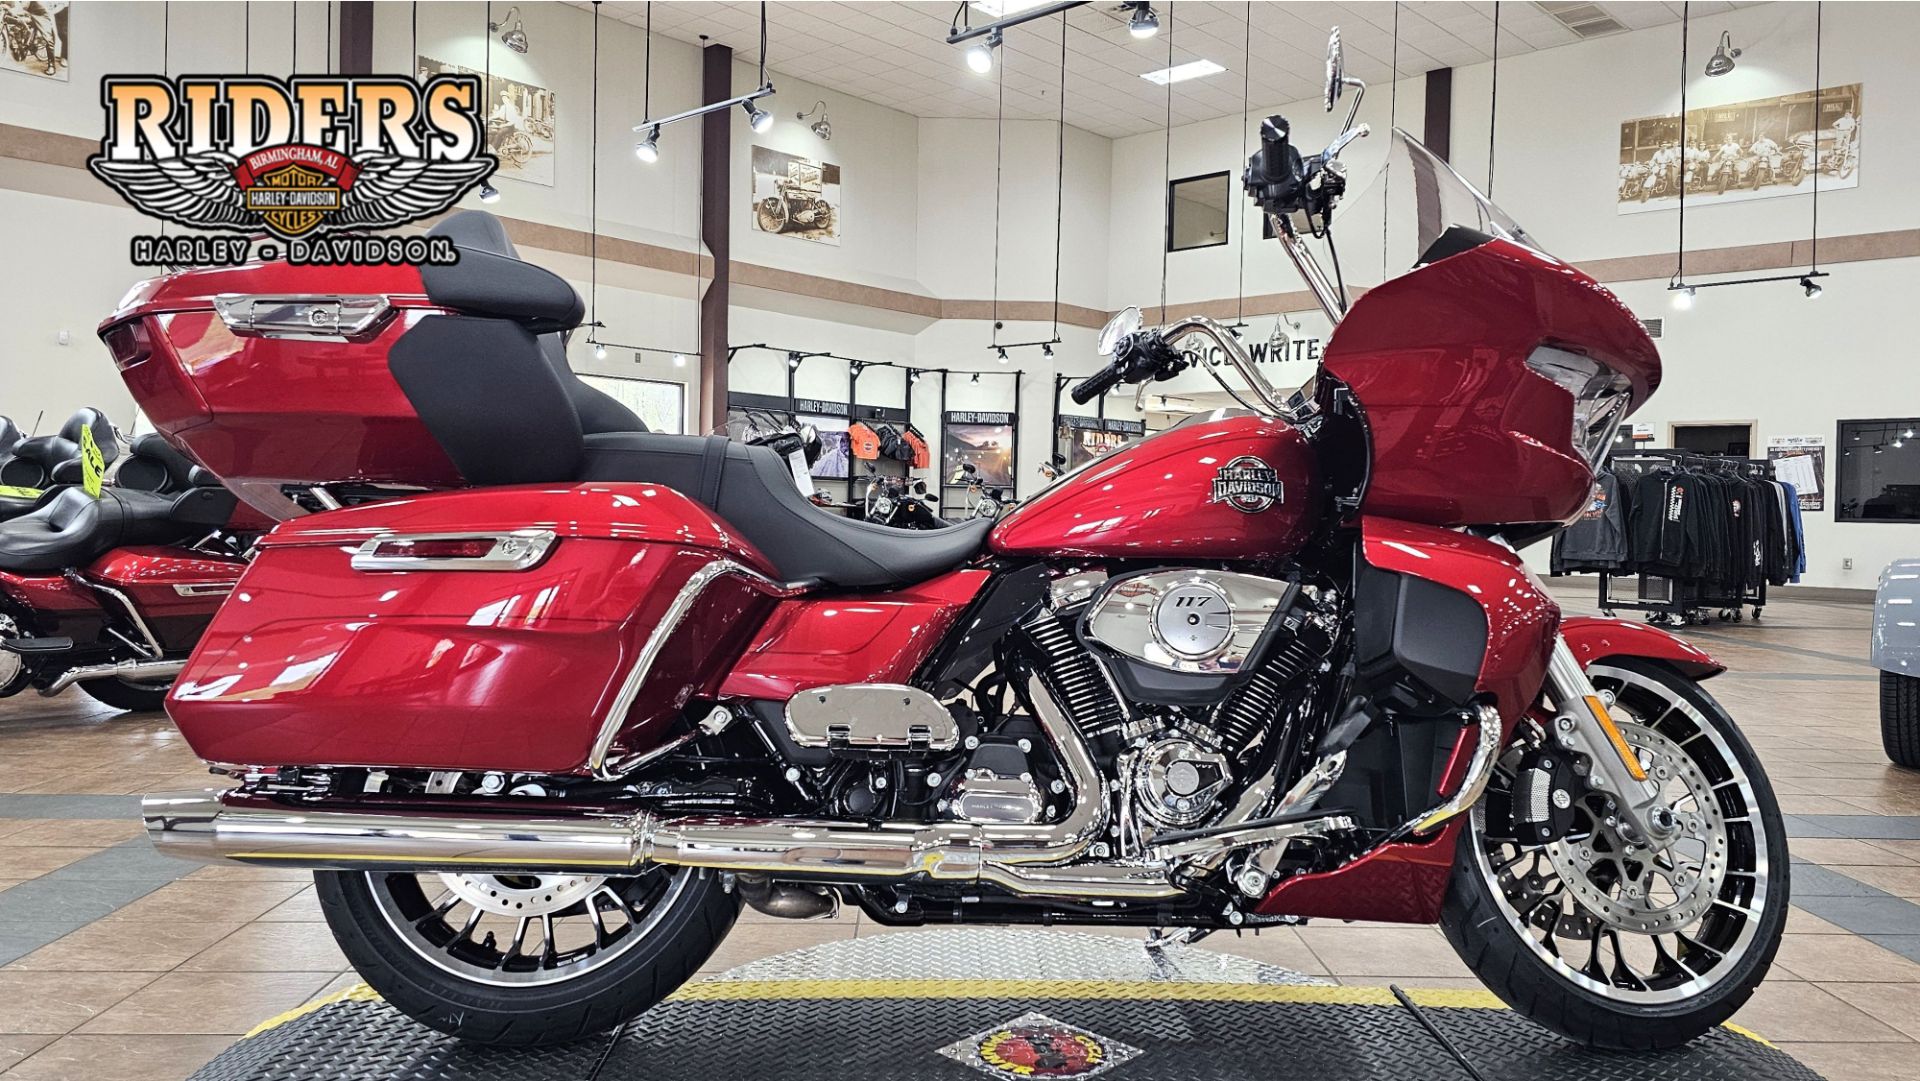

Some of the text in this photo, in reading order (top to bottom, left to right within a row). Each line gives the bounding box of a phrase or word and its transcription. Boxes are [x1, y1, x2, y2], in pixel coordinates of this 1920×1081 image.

[799, 399, 848, 415] HARLEY-DAVIDSON
[950, 411, 1009, 424] HARLEY-DAVIDSON
[1216, 481, 1281, 499] DAVIDSON
[1175, 596, 1212, 607] 117
